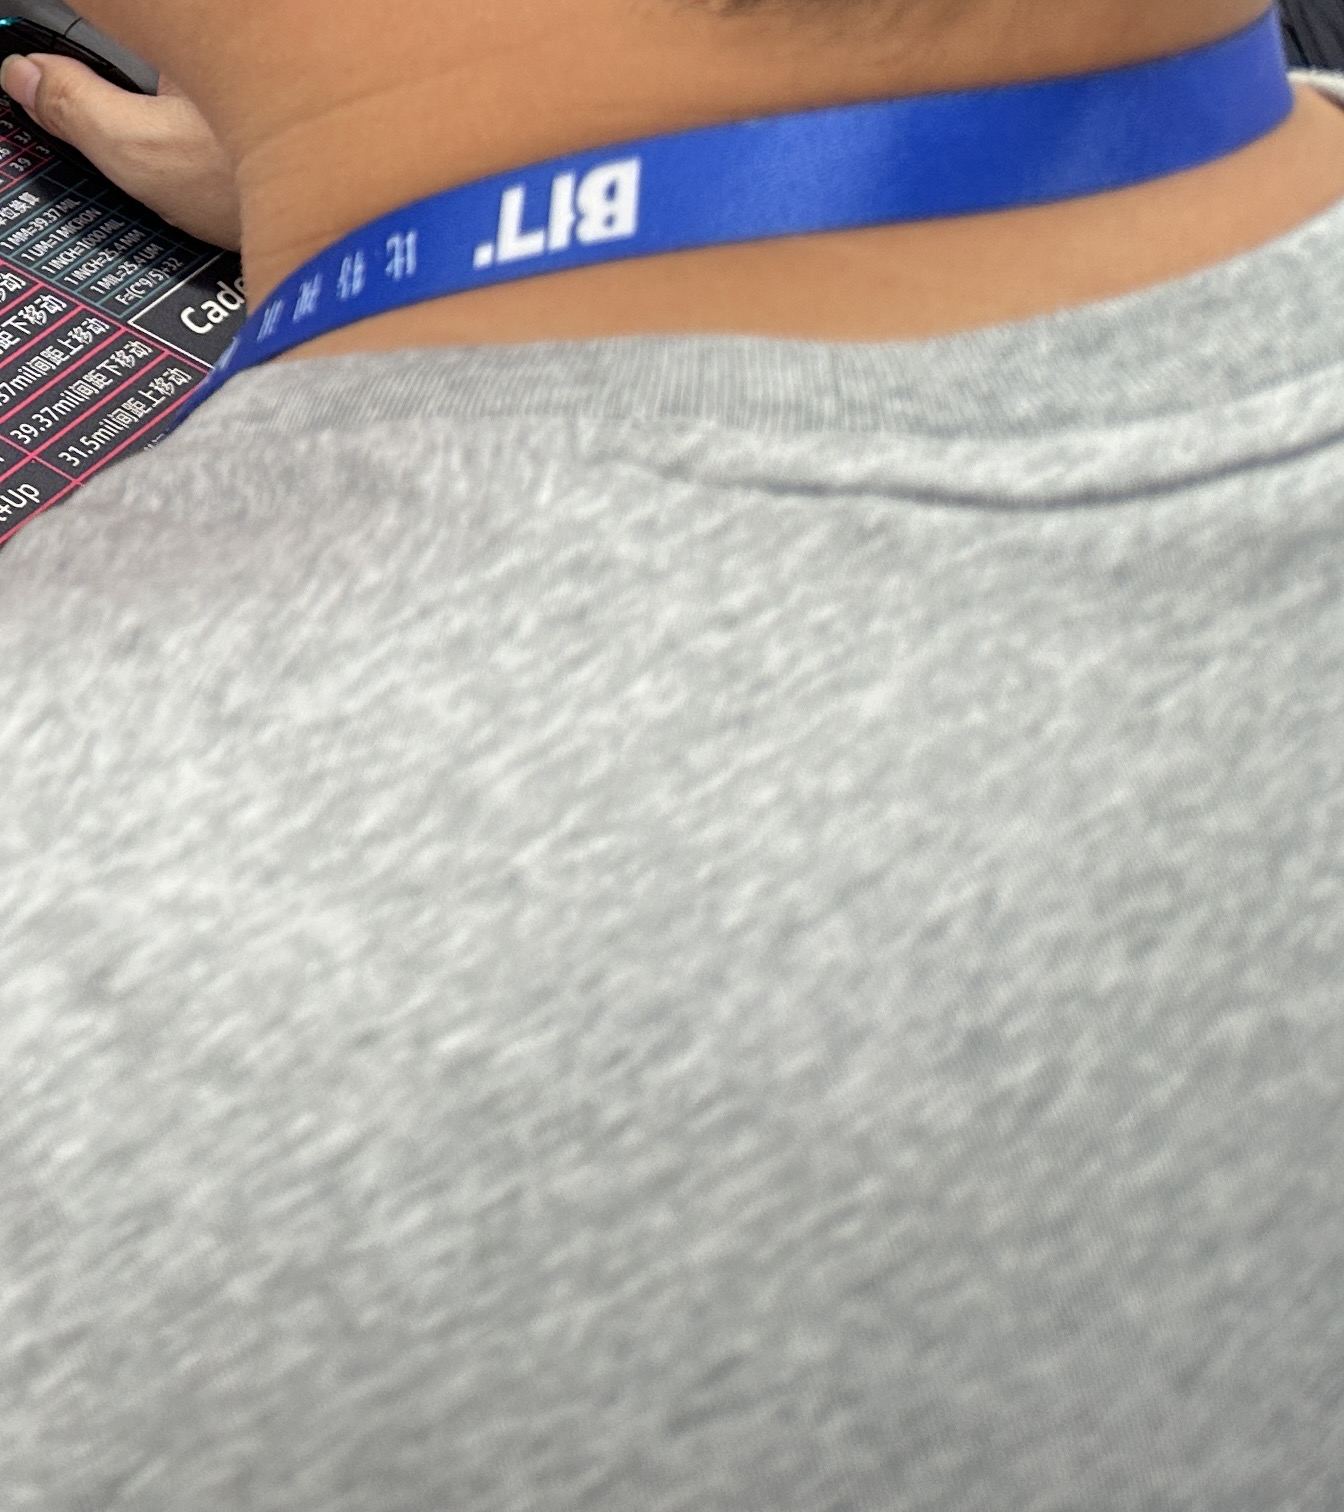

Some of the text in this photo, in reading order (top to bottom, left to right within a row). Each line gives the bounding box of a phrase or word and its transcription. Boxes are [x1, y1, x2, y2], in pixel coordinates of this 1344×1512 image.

[498, 155, 641, 270] BIT
[10, 338, 155, 446] 39.37mil间距下移动
[58, 365, 193, 468] 31.5mil间距上移动
